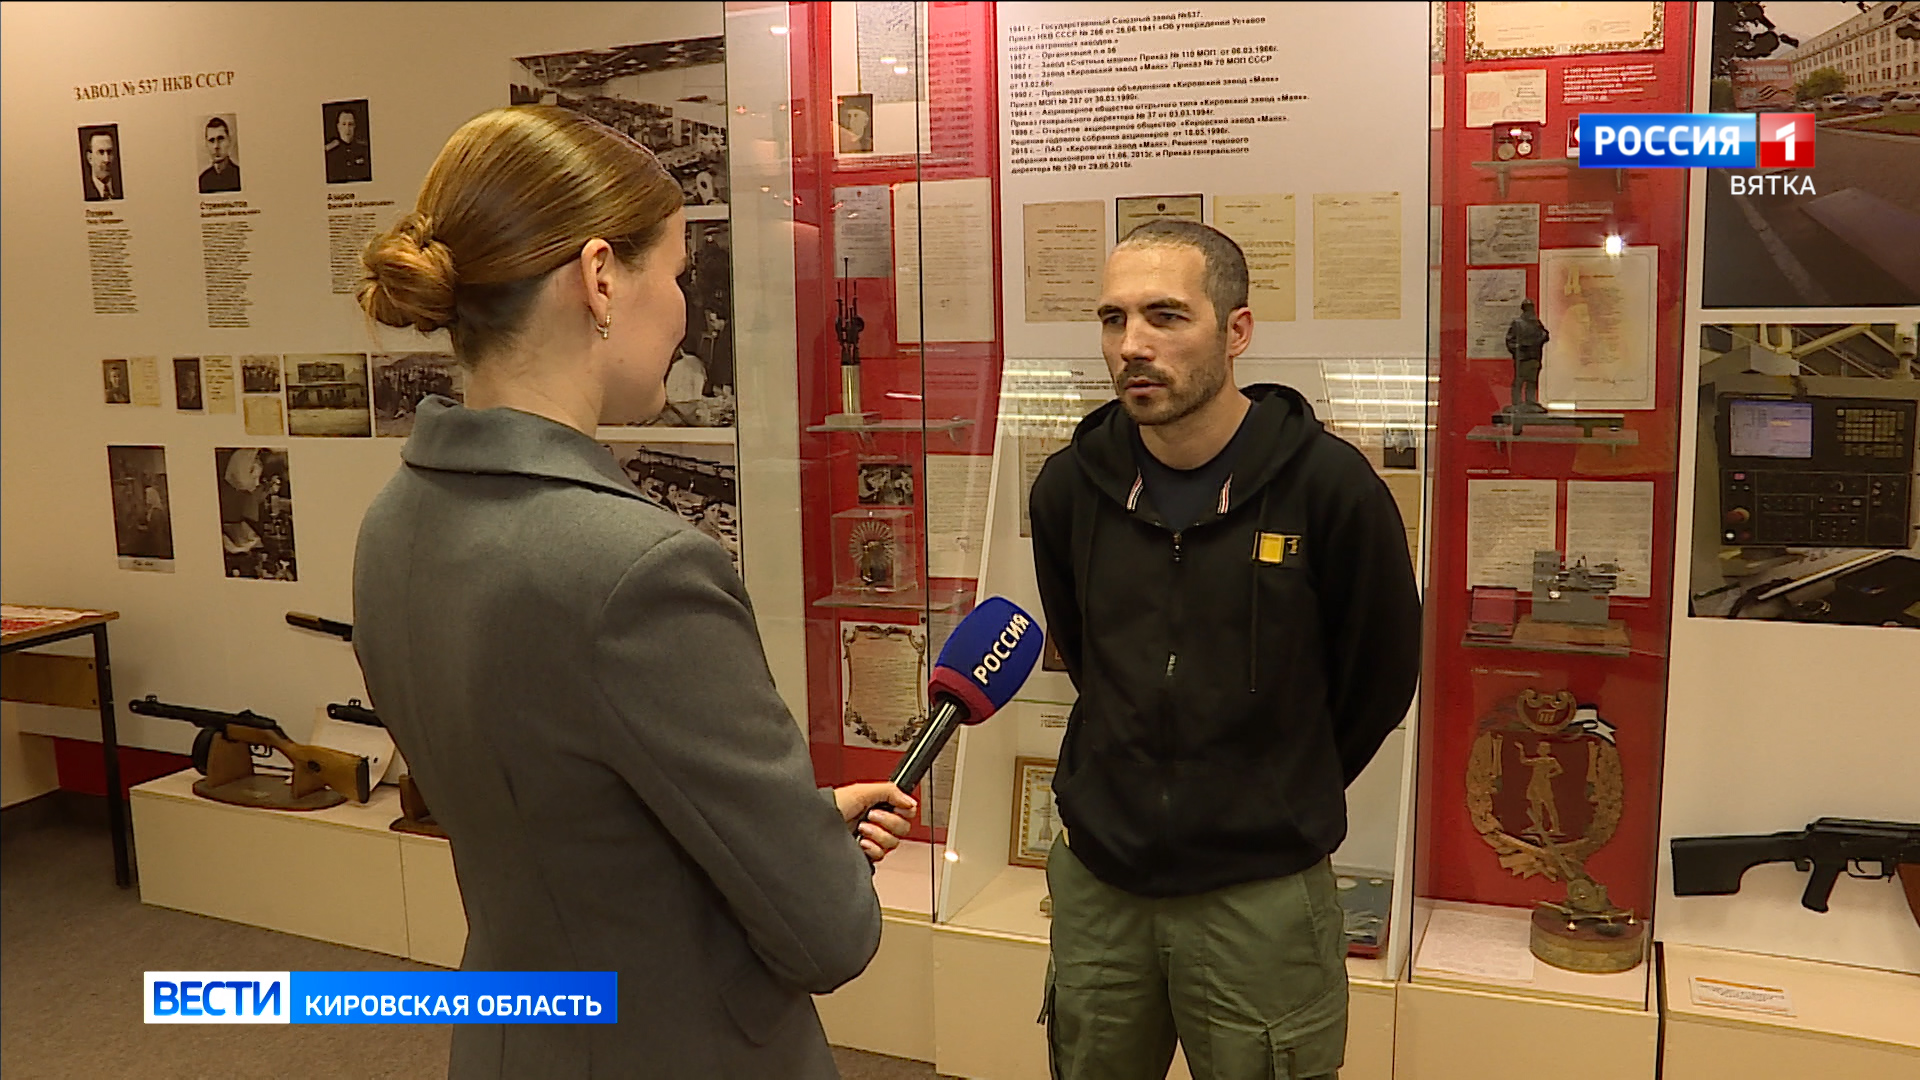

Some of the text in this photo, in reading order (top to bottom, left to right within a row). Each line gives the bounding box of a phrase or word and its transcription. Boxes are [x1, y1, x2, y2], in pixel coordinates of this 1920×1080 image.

[1055, 30, 1077, 38] СССР
[1248, 56, 1272, 64] СССР
[74, 71, 234, 100] ЗАВОД № 537 НКВ СССР
[973, 613, 1030, 685] РОССИЯ
